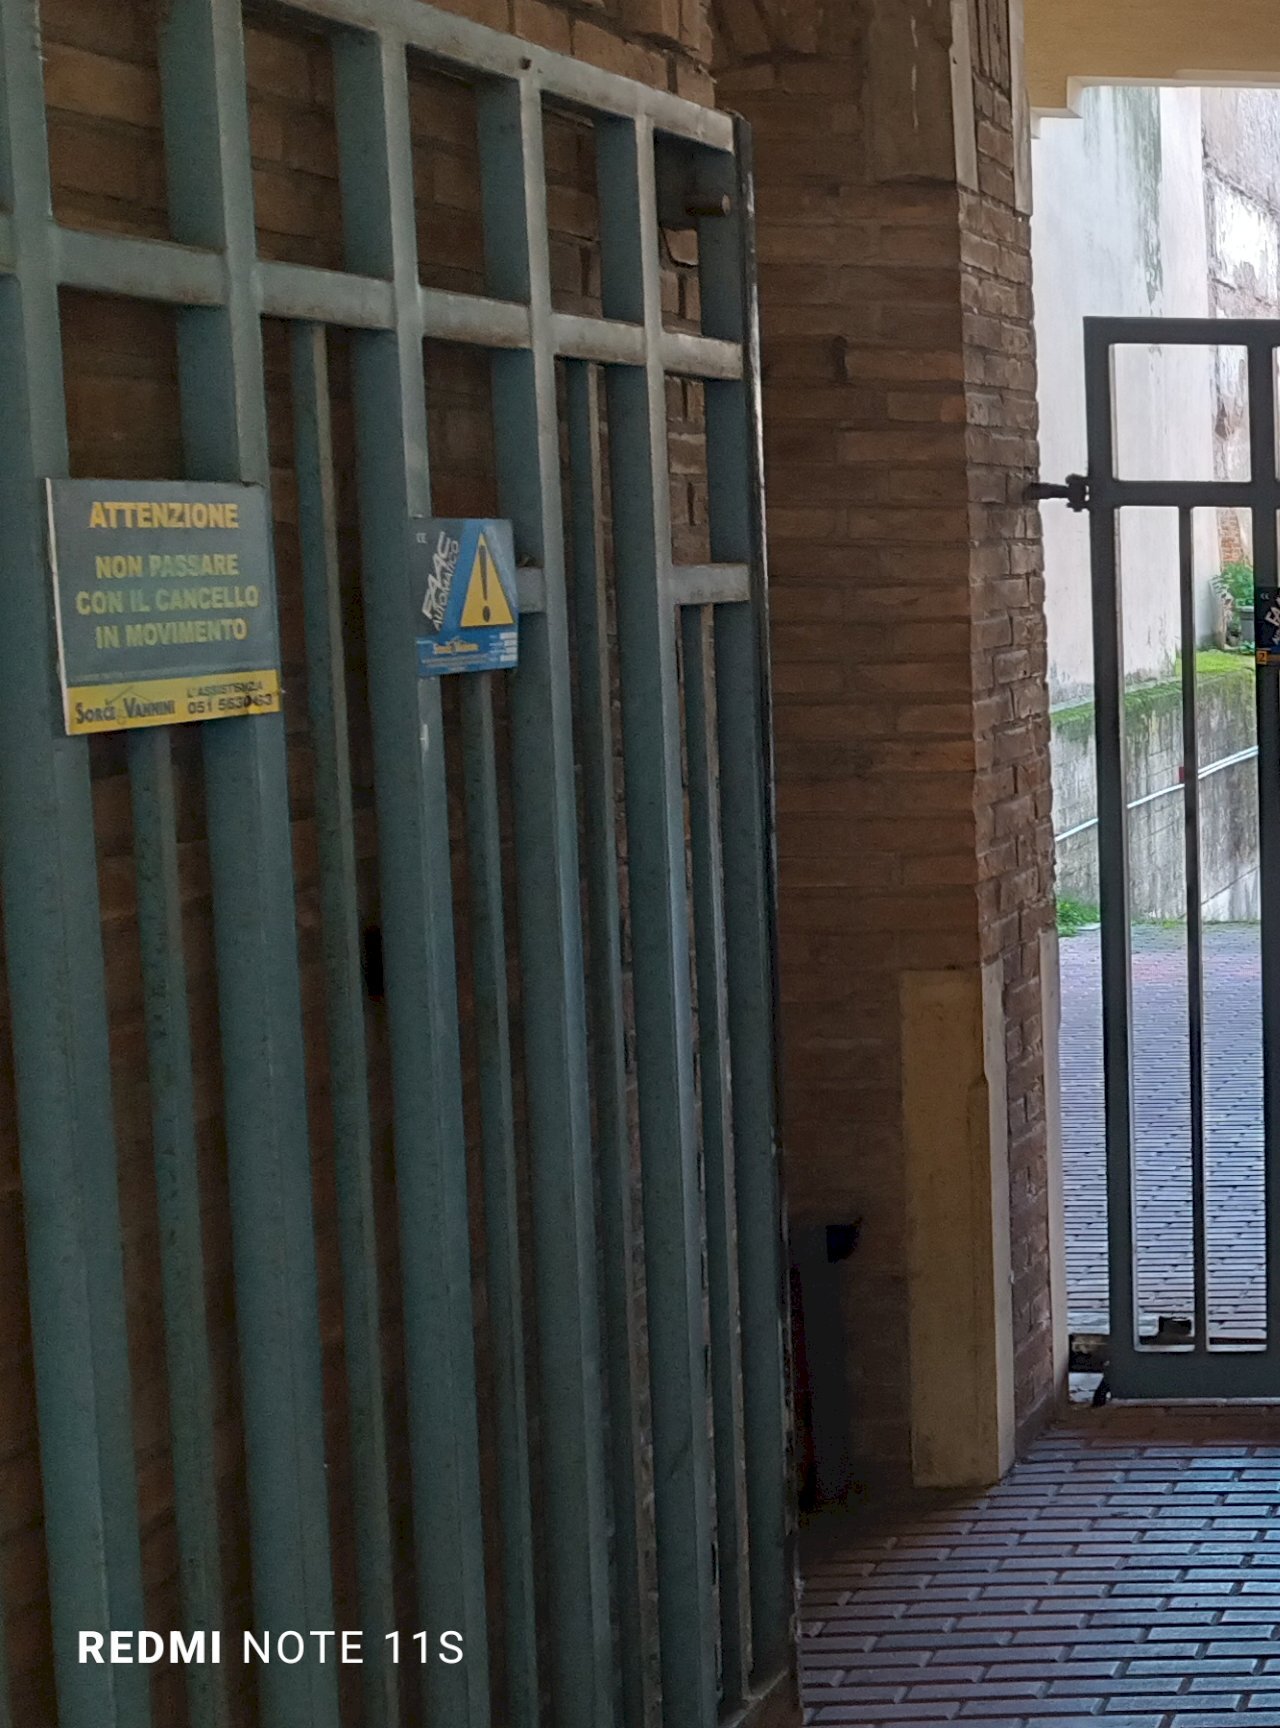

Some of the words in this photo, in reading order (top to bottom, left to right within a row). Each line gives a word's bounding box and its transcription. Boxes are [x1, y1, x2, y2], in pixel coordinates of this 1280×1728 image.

[89, 501, 239, 528] ATTENZIONE
[96, 555, 142, 579] NON
[150, 553, 239, 577] PASSARE
[76, 590, 123, 615] CON
[131, 589, 150, 612] IL
[156, 585, 260, 611] CANCELLO
[96, 626, 120, 649] IN
[127, 618, 248, 646] MOVIMENTO
[188, 700, 212, 714] 051
